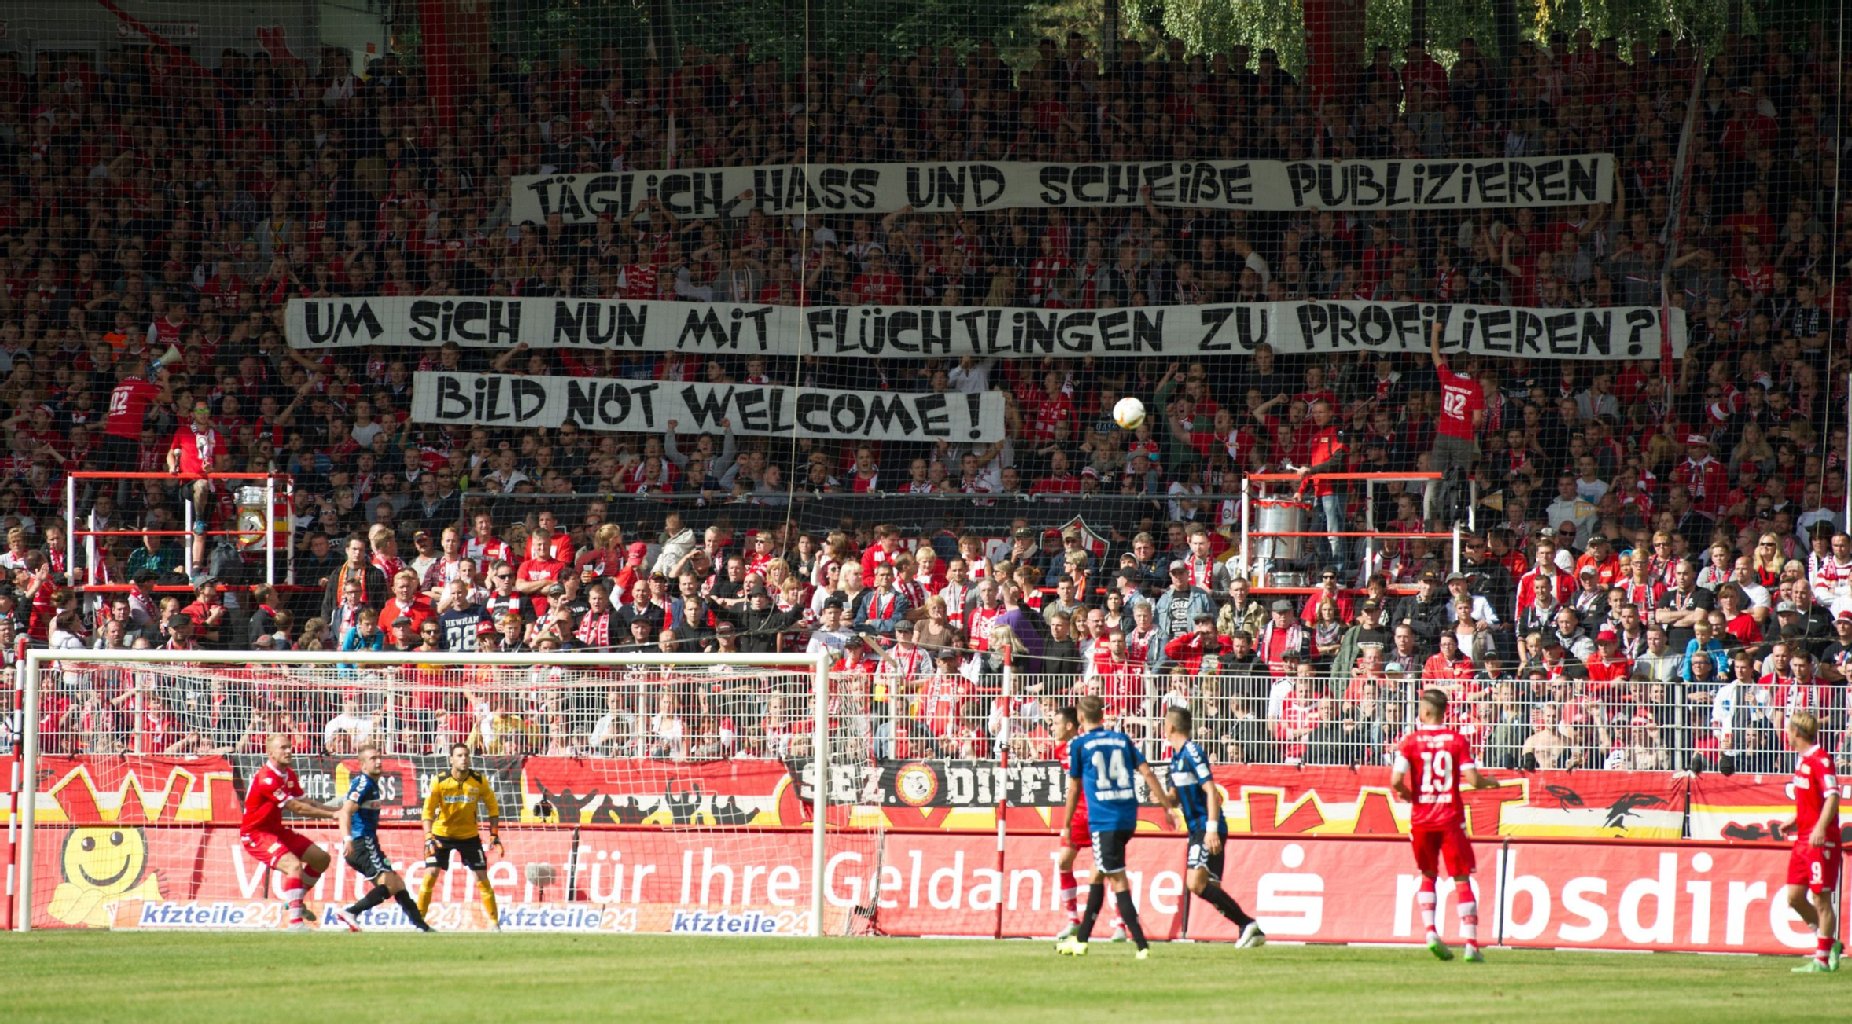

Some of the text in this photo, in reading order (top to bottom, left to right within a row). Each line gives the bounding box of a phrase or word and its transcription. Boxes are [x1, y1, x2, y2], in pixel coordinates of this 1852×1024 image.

[754, 166, 880, 211] HASS
[906, 163, 1006, 208] UND
[305, 299, 384, 344] UM
[554, 301, 647, 348] NUN
[1200, 306, 1268, 350] ZU
[566, 380, 659, 428] NOT
[1091, 749, 1130, 791] 14
[1420, 750, 1453, 793] 19
[680, 847, 801, 906] Ihre
[1810, 861, 1823, 884] 9
[141, 903, 281, 926] kfzteile24
[499, 905, 637, 930] kfzteile24
[1392, 850, 1852, 948] mbsdire
[674, 909, 812, 933] kfzteile24
